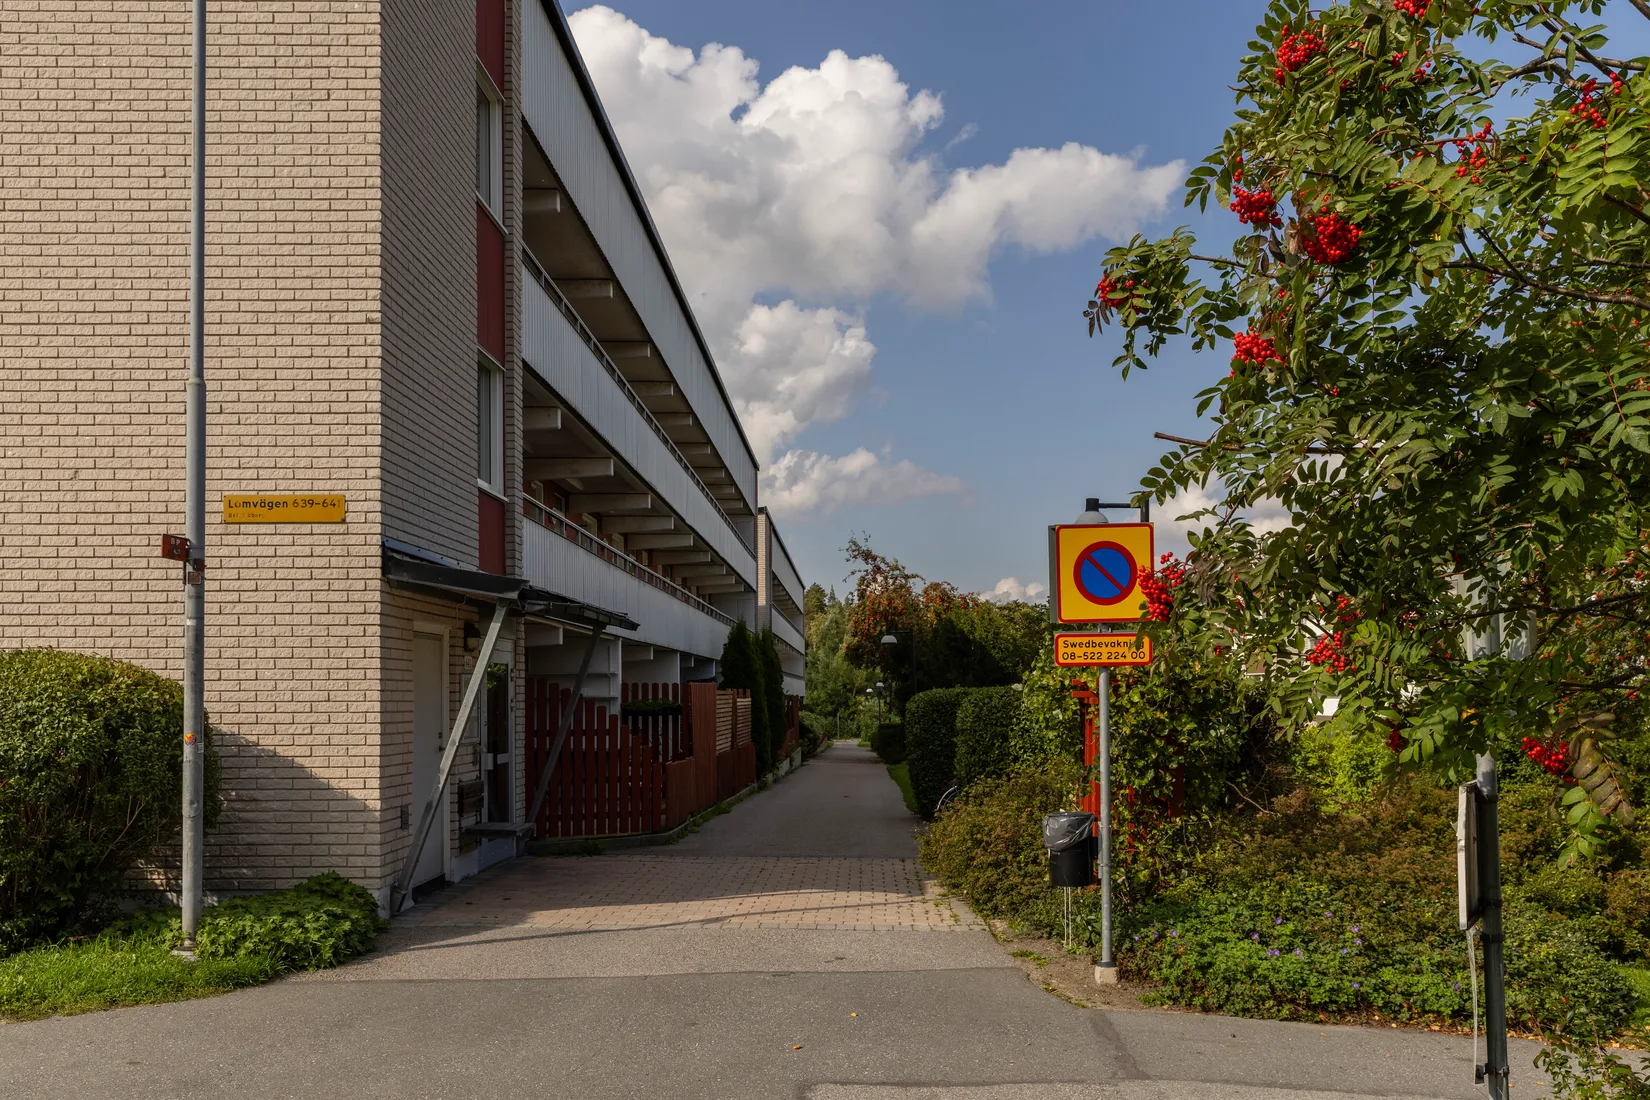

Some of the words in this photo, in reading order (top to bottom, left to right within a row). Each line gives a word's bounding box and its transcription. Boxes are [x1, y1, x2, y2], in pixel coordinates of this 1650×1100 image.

[1062, 651, 1103, 661] 08-522
[1106, 651, 1127, 660] 224
[1130, 651, 1146, 660] 00
